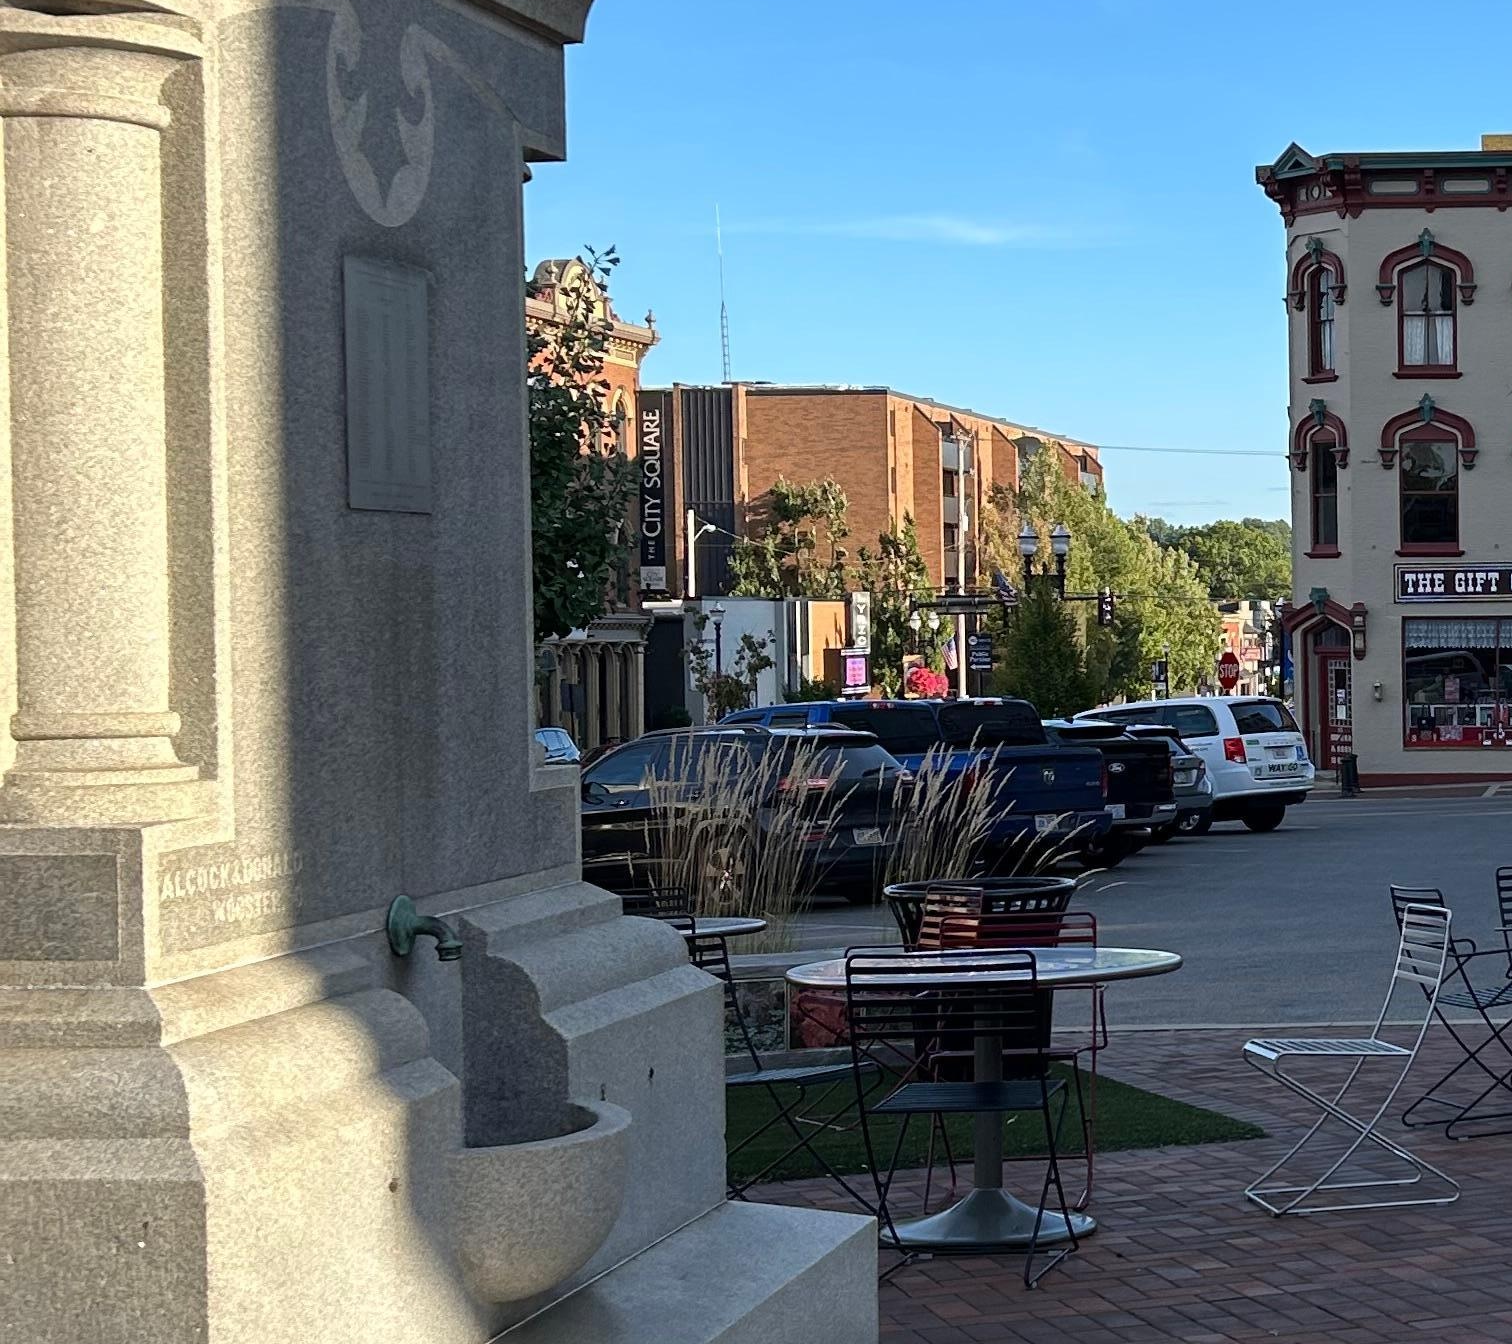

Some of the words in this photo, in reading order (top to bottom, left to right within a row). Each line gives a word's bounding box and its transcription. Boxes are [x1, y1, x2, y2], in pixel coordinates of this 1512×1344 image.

[642, 409, 661, 488] SQUARE
[642, 496, 661, 538] CITY
[648, 541, 656, 560] THE
[1404, 573, 1445, 594] THE
[1455, 572, 1500, 593] GIFT
[1220, 663, 1239, 678] STOP
[1267, 762, 1285, 773] WAY
